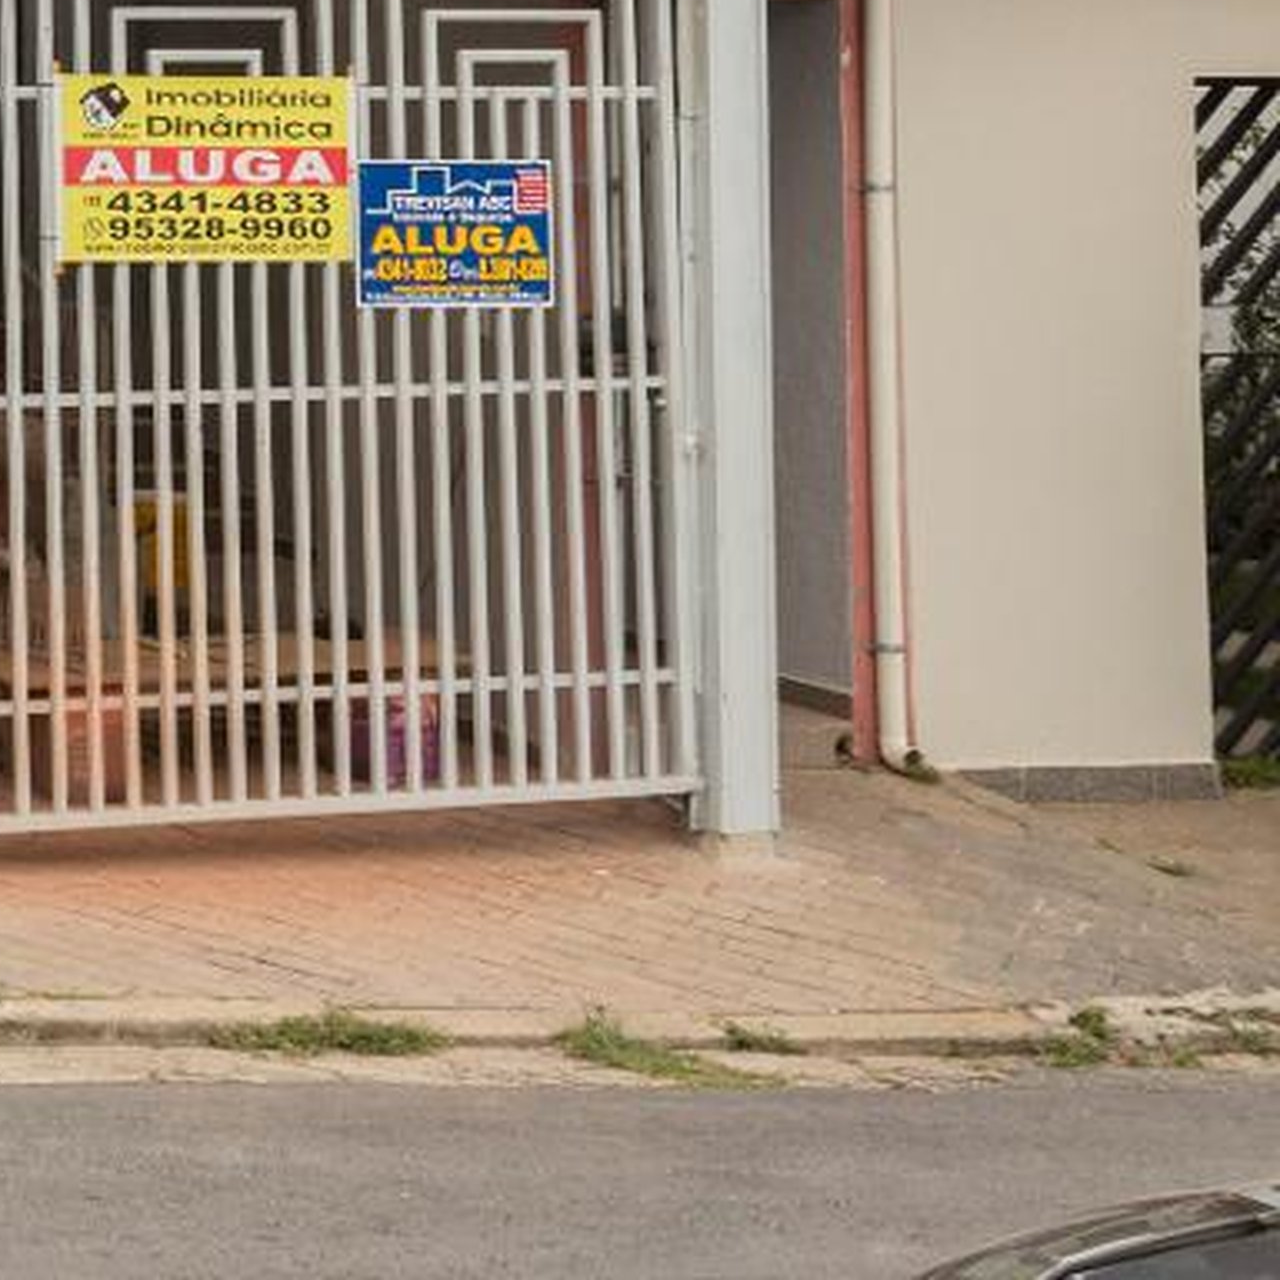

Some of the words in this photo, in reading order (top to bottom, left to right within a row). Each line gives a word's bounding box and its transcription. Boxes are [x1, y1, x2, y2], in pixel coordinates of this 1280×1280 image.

[145, 88, 333, 109] Imobiliária
[145, 114, 333, 140] Dinâmica
[80, 150, 336, 183] ALUGA
[107, 191, 331, 214] 4341-4833
[108, 217, 333, 240] 95328-9960
[372, 225, 539, 255] ALUGA
